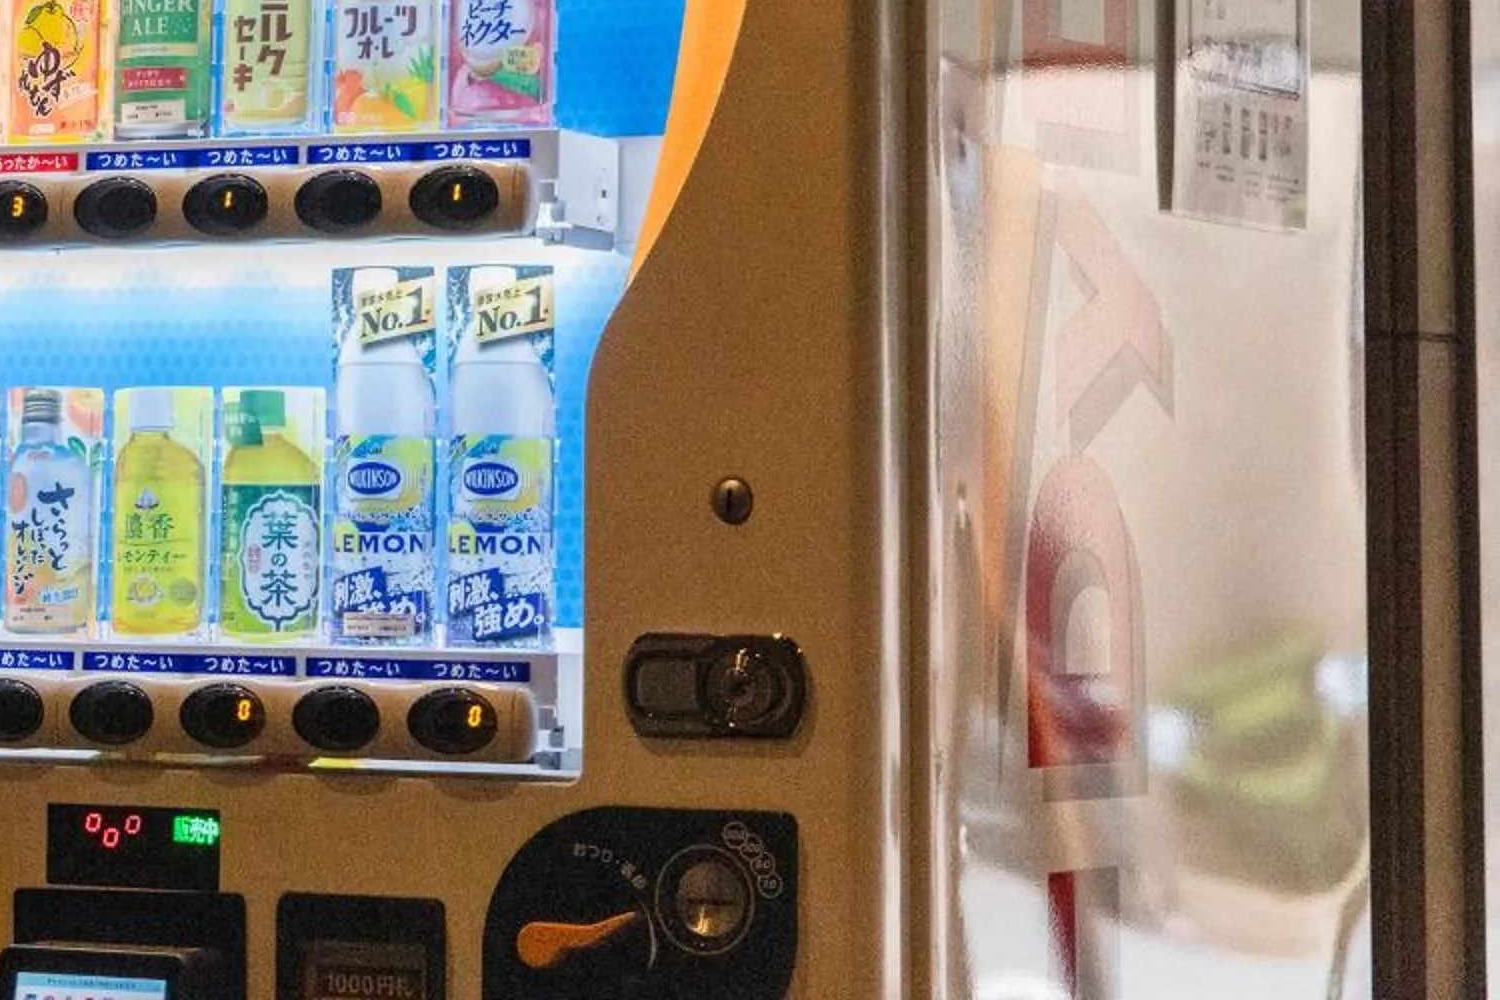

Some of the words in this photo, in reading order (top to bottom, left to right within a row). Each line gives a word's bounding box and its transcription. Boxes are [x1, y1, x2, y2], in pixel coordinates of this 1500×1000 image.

[131, 15, 169, 37] ALE
[344, 5, 418, 39] フルーツ
[461, 18, 527, 47] ネクター
[468, 0, 513, 19] ピーチ
[27, 41, 77, 102] ゆず
[232, 15, 257, 93] セーキ
[11, 195, 24, 217] 3
[359, 284, 428, 339] No.1
[476, 284, 549, 338] No.1
[31, 506, 50, 565] しぼった
[37, 482, 75, 572] さらっと
[123, 512, 175, 541] 濃香
[11, 519, 35, 595] オレンジ
[260, 511, 300, 608] 葉の茶
[474, 598, 544, 638] 強め。
